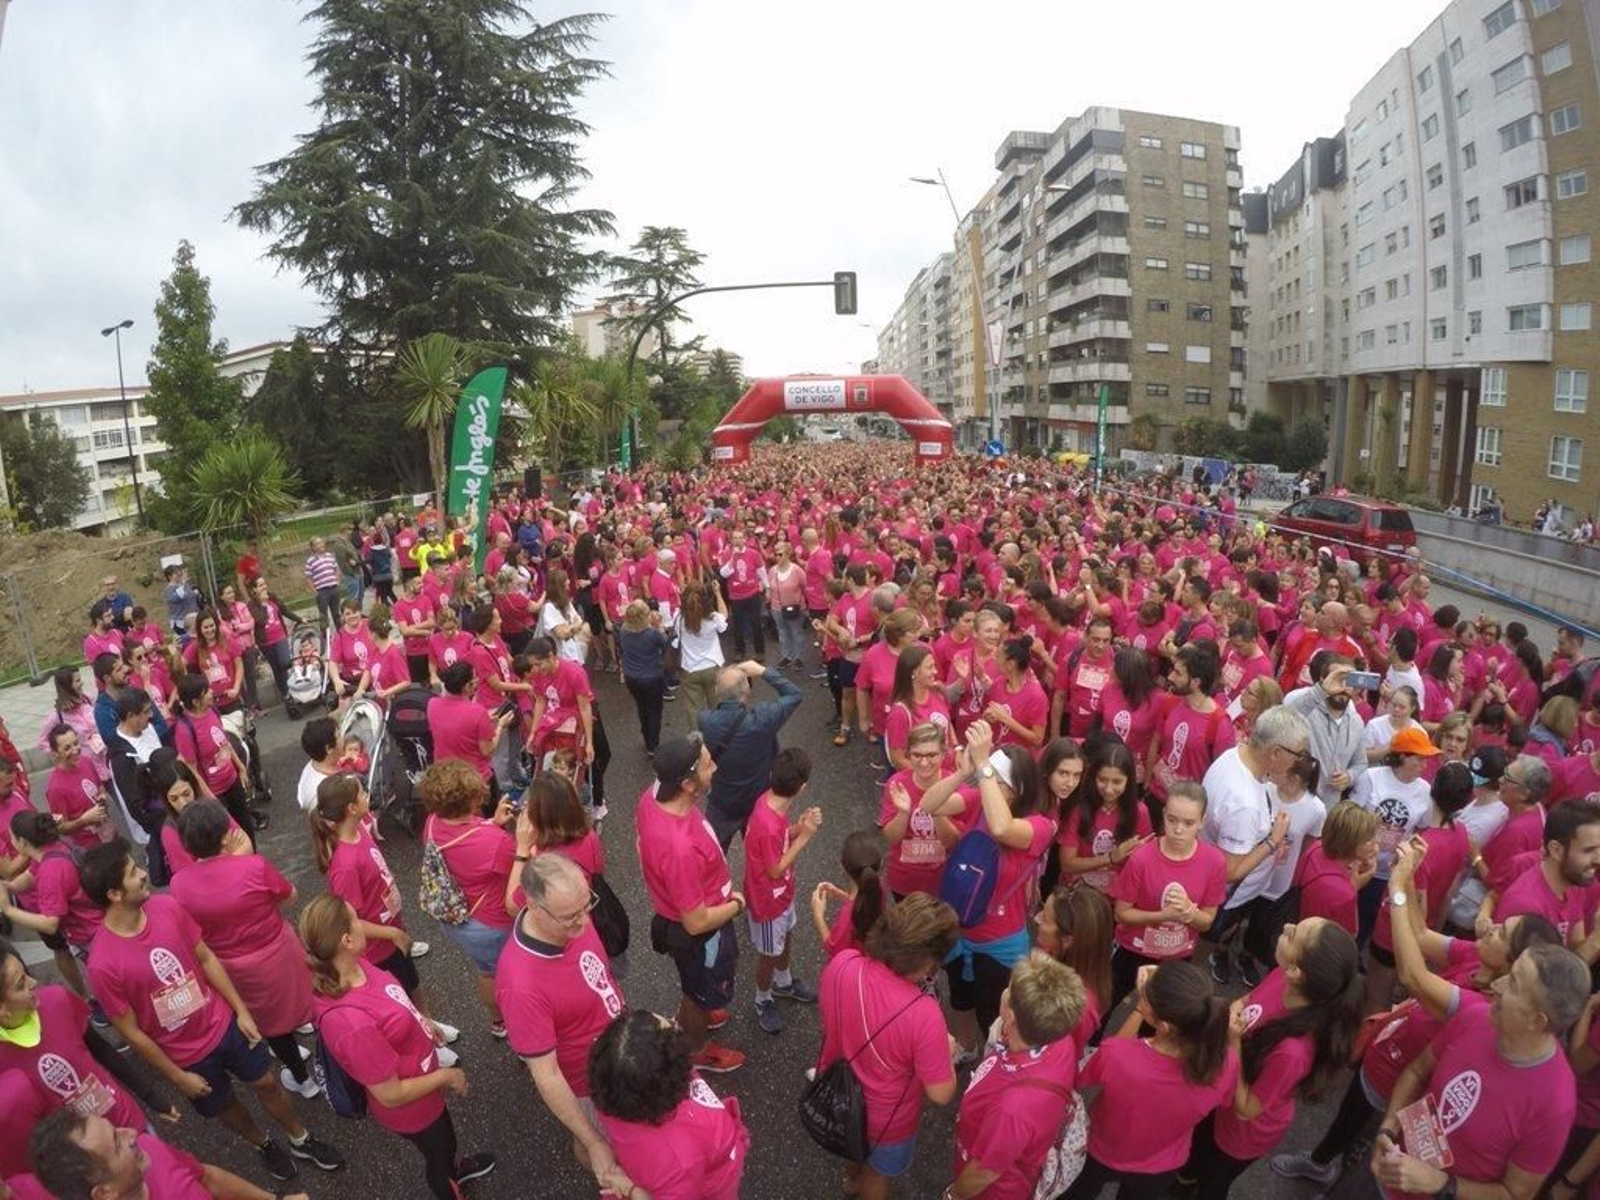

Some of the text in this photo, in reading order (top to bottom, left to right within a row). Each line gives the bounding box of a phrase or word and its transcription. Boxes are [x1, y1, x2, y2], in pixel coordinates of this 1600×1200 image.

[788, 385, 841, 394] CONCELLO
[794, 395, 835, 404] DE VIGO
[75, 1093, 99, 1116] 912
